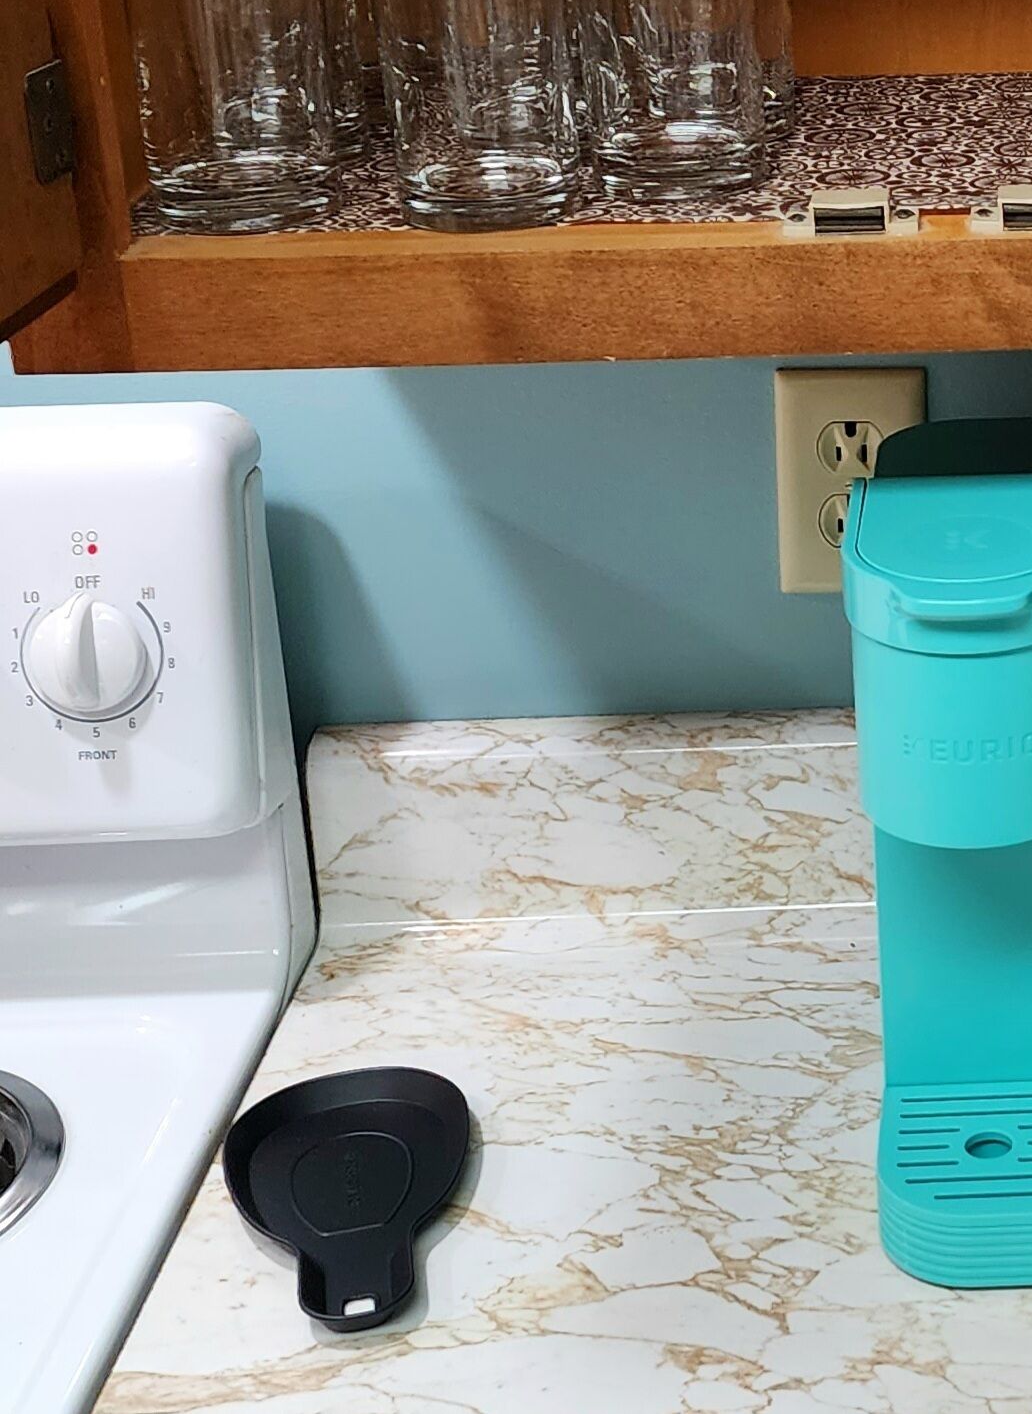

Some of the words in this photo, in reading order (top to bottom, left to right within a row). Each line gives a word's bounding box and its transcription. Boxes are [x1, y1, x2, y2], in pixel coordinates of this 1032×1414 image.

[74, 574, 101, 589] OFF
[23, 591, 39, 604] LO
[141, 587, 156, 600] HI
[163, 622, 171, 632] 9
[12, 628, 19, 639] 1
[11, 662, 19, 673] 2
[168, 658, 175, 668] 8
[26, 696, 34, 706] 3
[157, 693, 163, 703] 7
[55, 719, 63, 730] 4
[128, 717, 137, 730] 6
[92, 727, 101, 739] 5
[77, 750, 118, 761] FRONT
